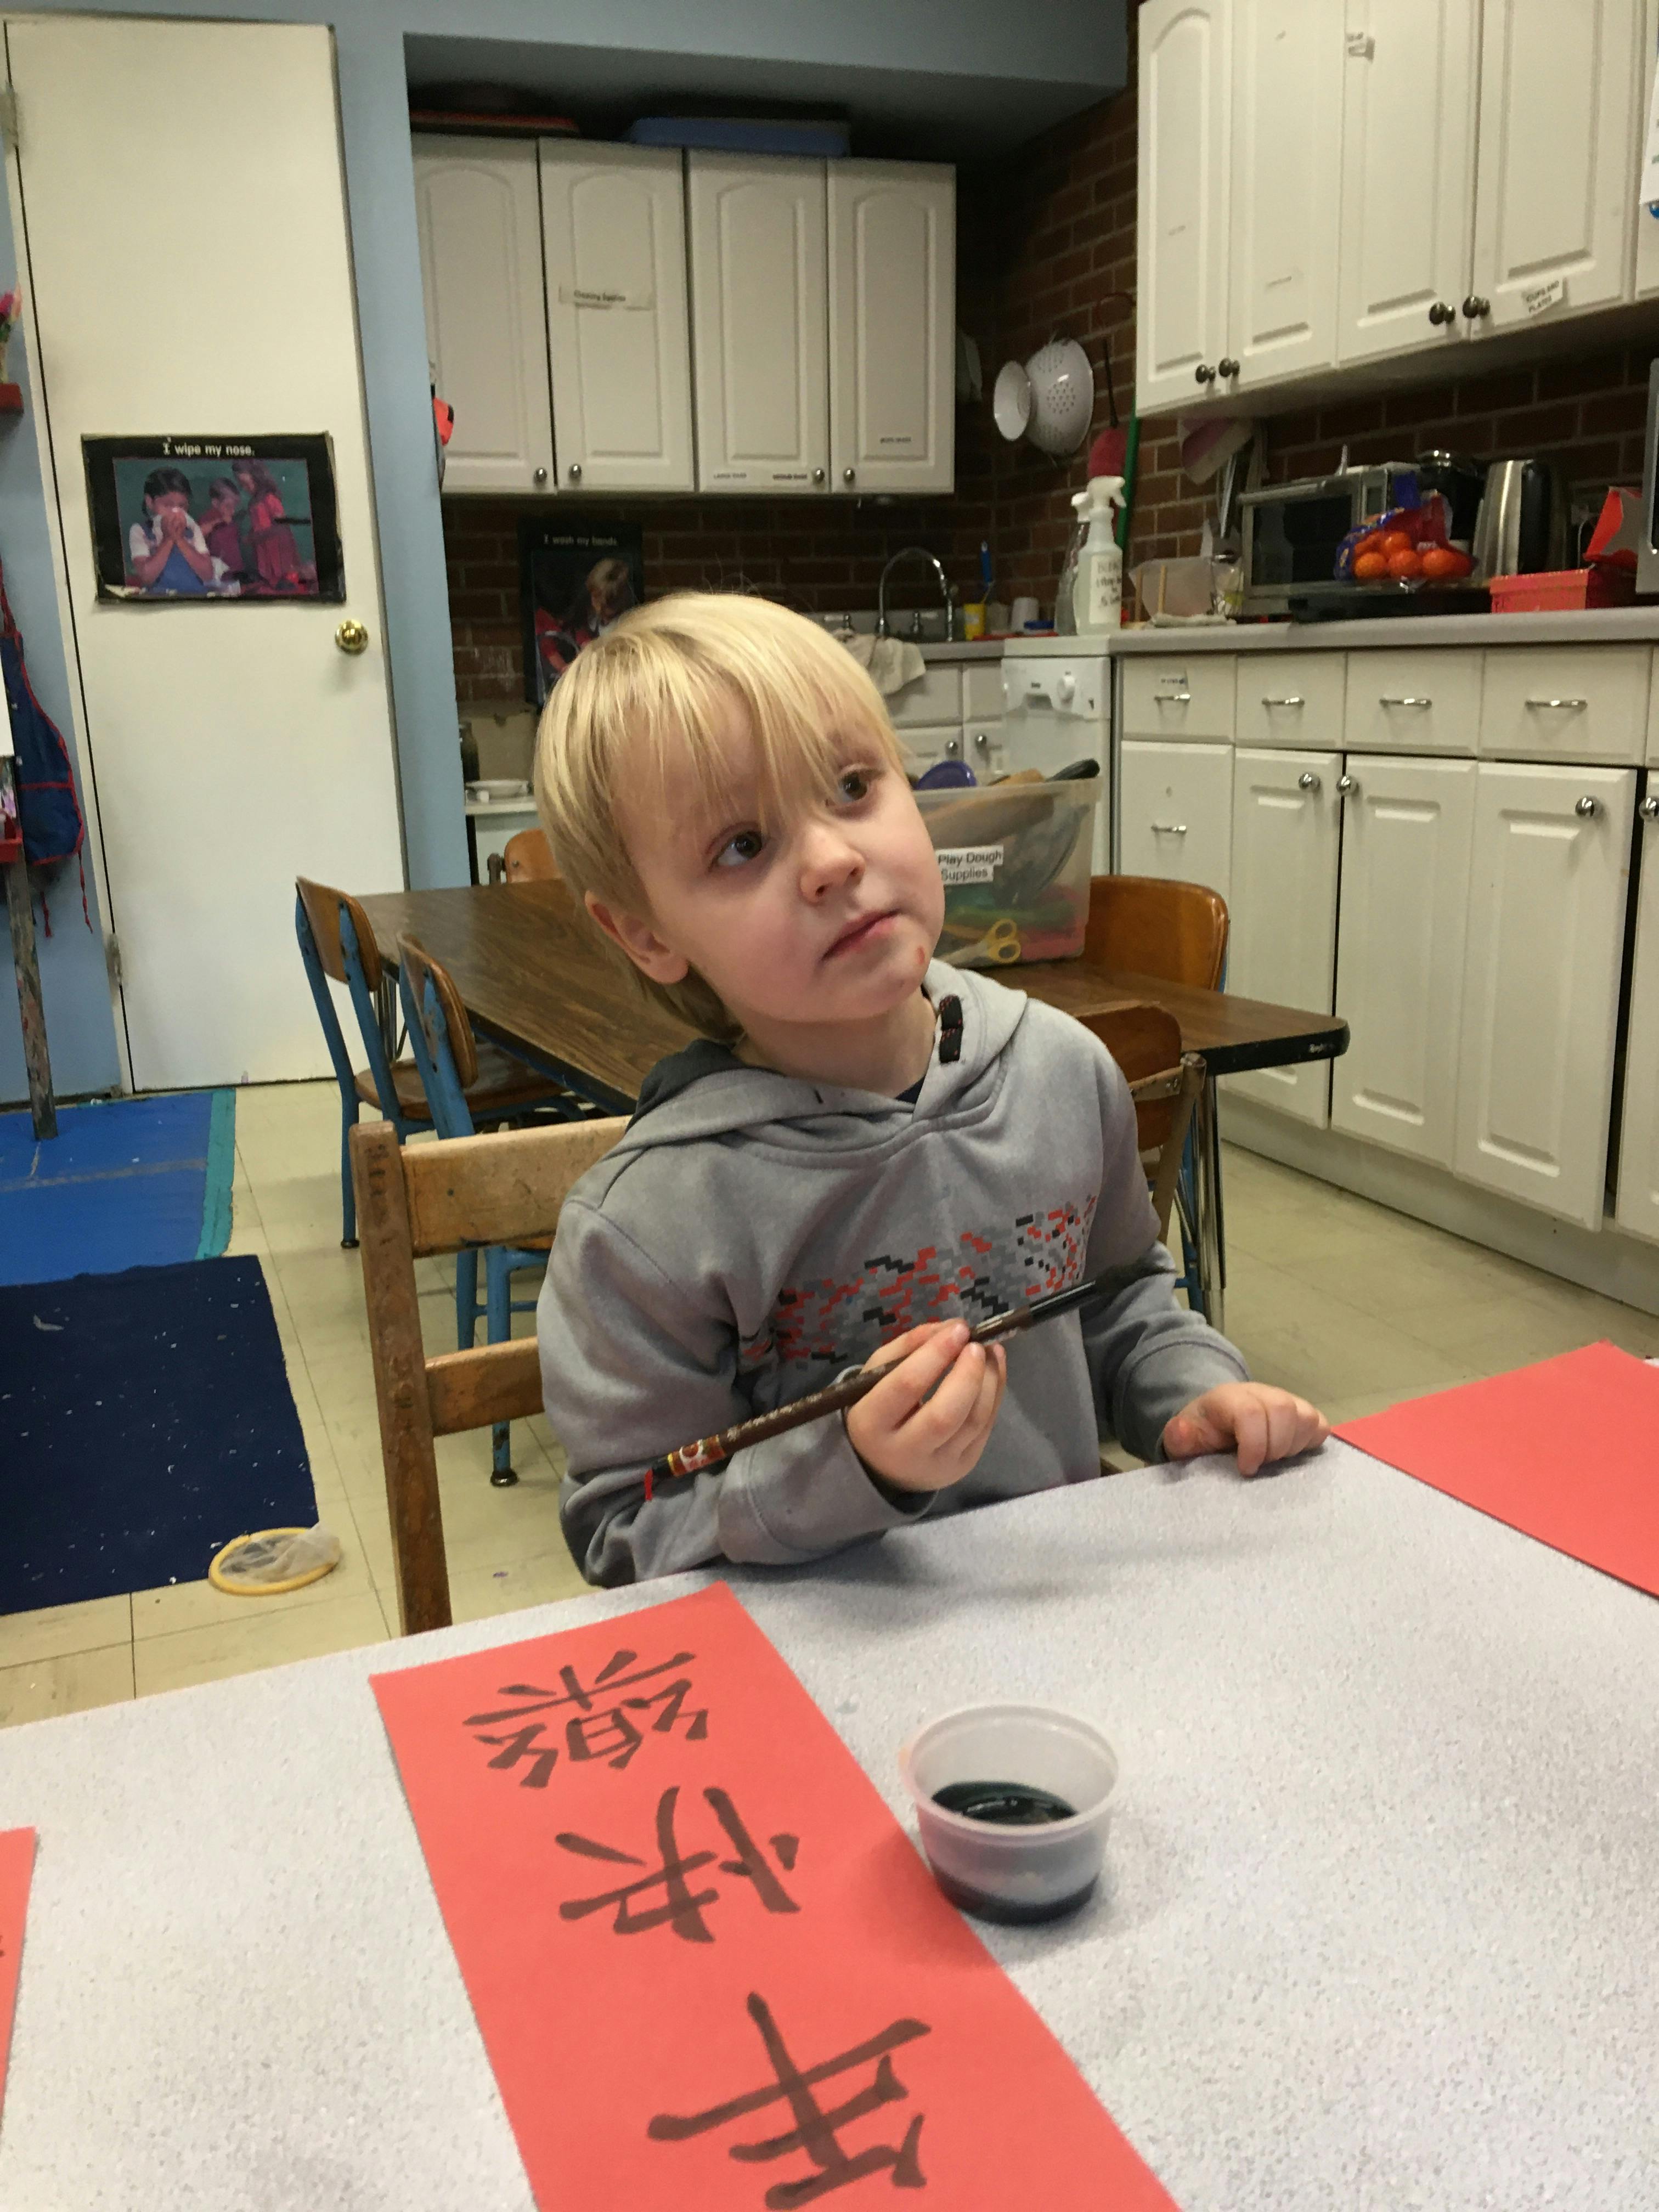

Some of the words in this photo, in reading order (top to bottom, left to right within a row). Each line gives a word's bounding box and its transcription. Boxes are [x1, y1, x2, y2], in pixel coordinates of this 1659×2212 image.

[162, 442, 171, 455] I
[174, 443, 201, 457] wipe
[205, 445, 222, 457] my
[938, 854, 963, 867] Play
[966, 850, 1002, 865] Dough
[941, 866, 988, 882] Supplies
